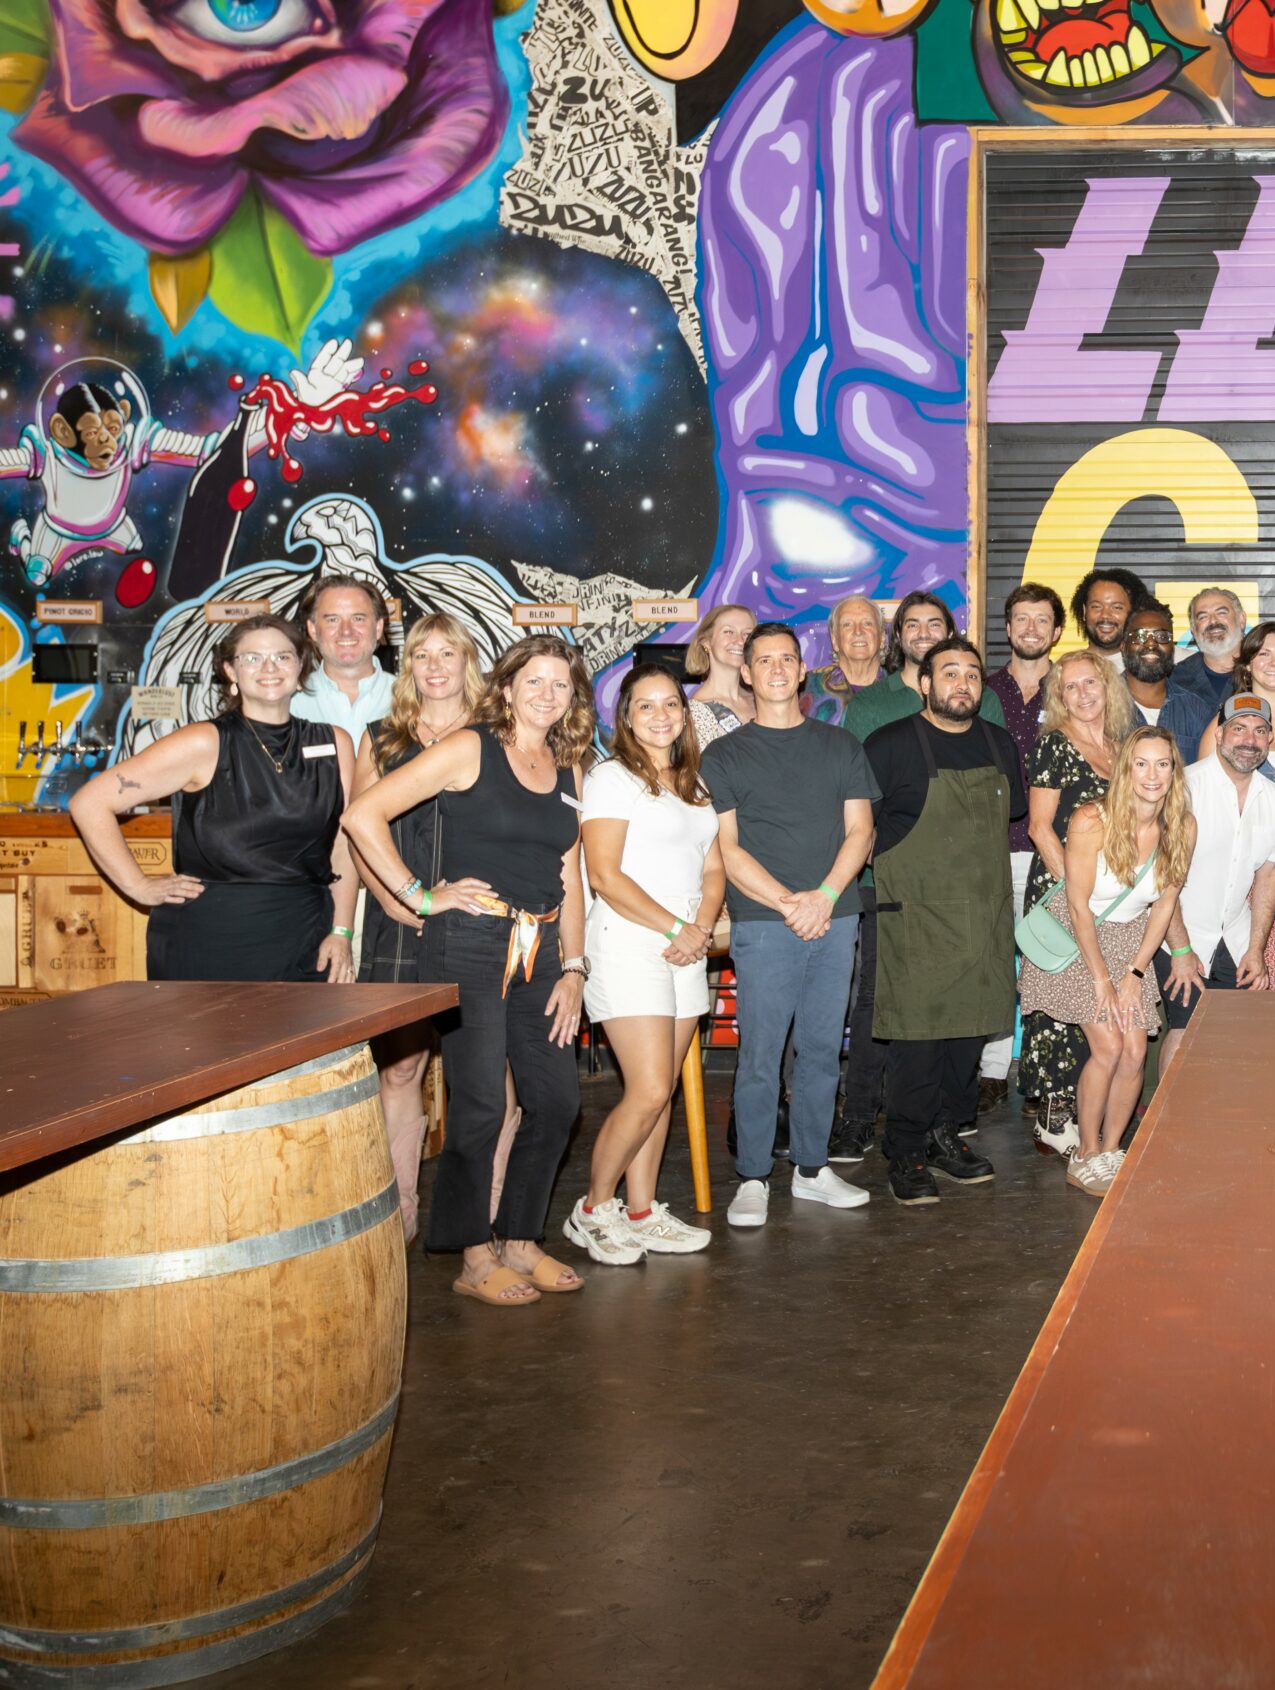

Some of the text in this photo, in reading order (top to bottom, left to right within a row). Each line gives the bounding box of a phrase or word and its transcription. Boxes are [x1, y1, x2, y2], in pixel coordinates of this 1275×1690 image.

[629, 122, 694, 275] BANGARANG!
[44, 607, 93, 616] PINOT GRIGIO
[224, 608, 250, 617] WORLD
[529, 610, 555, 619] BLEND
[651, 606, 679, 615] BLEND
